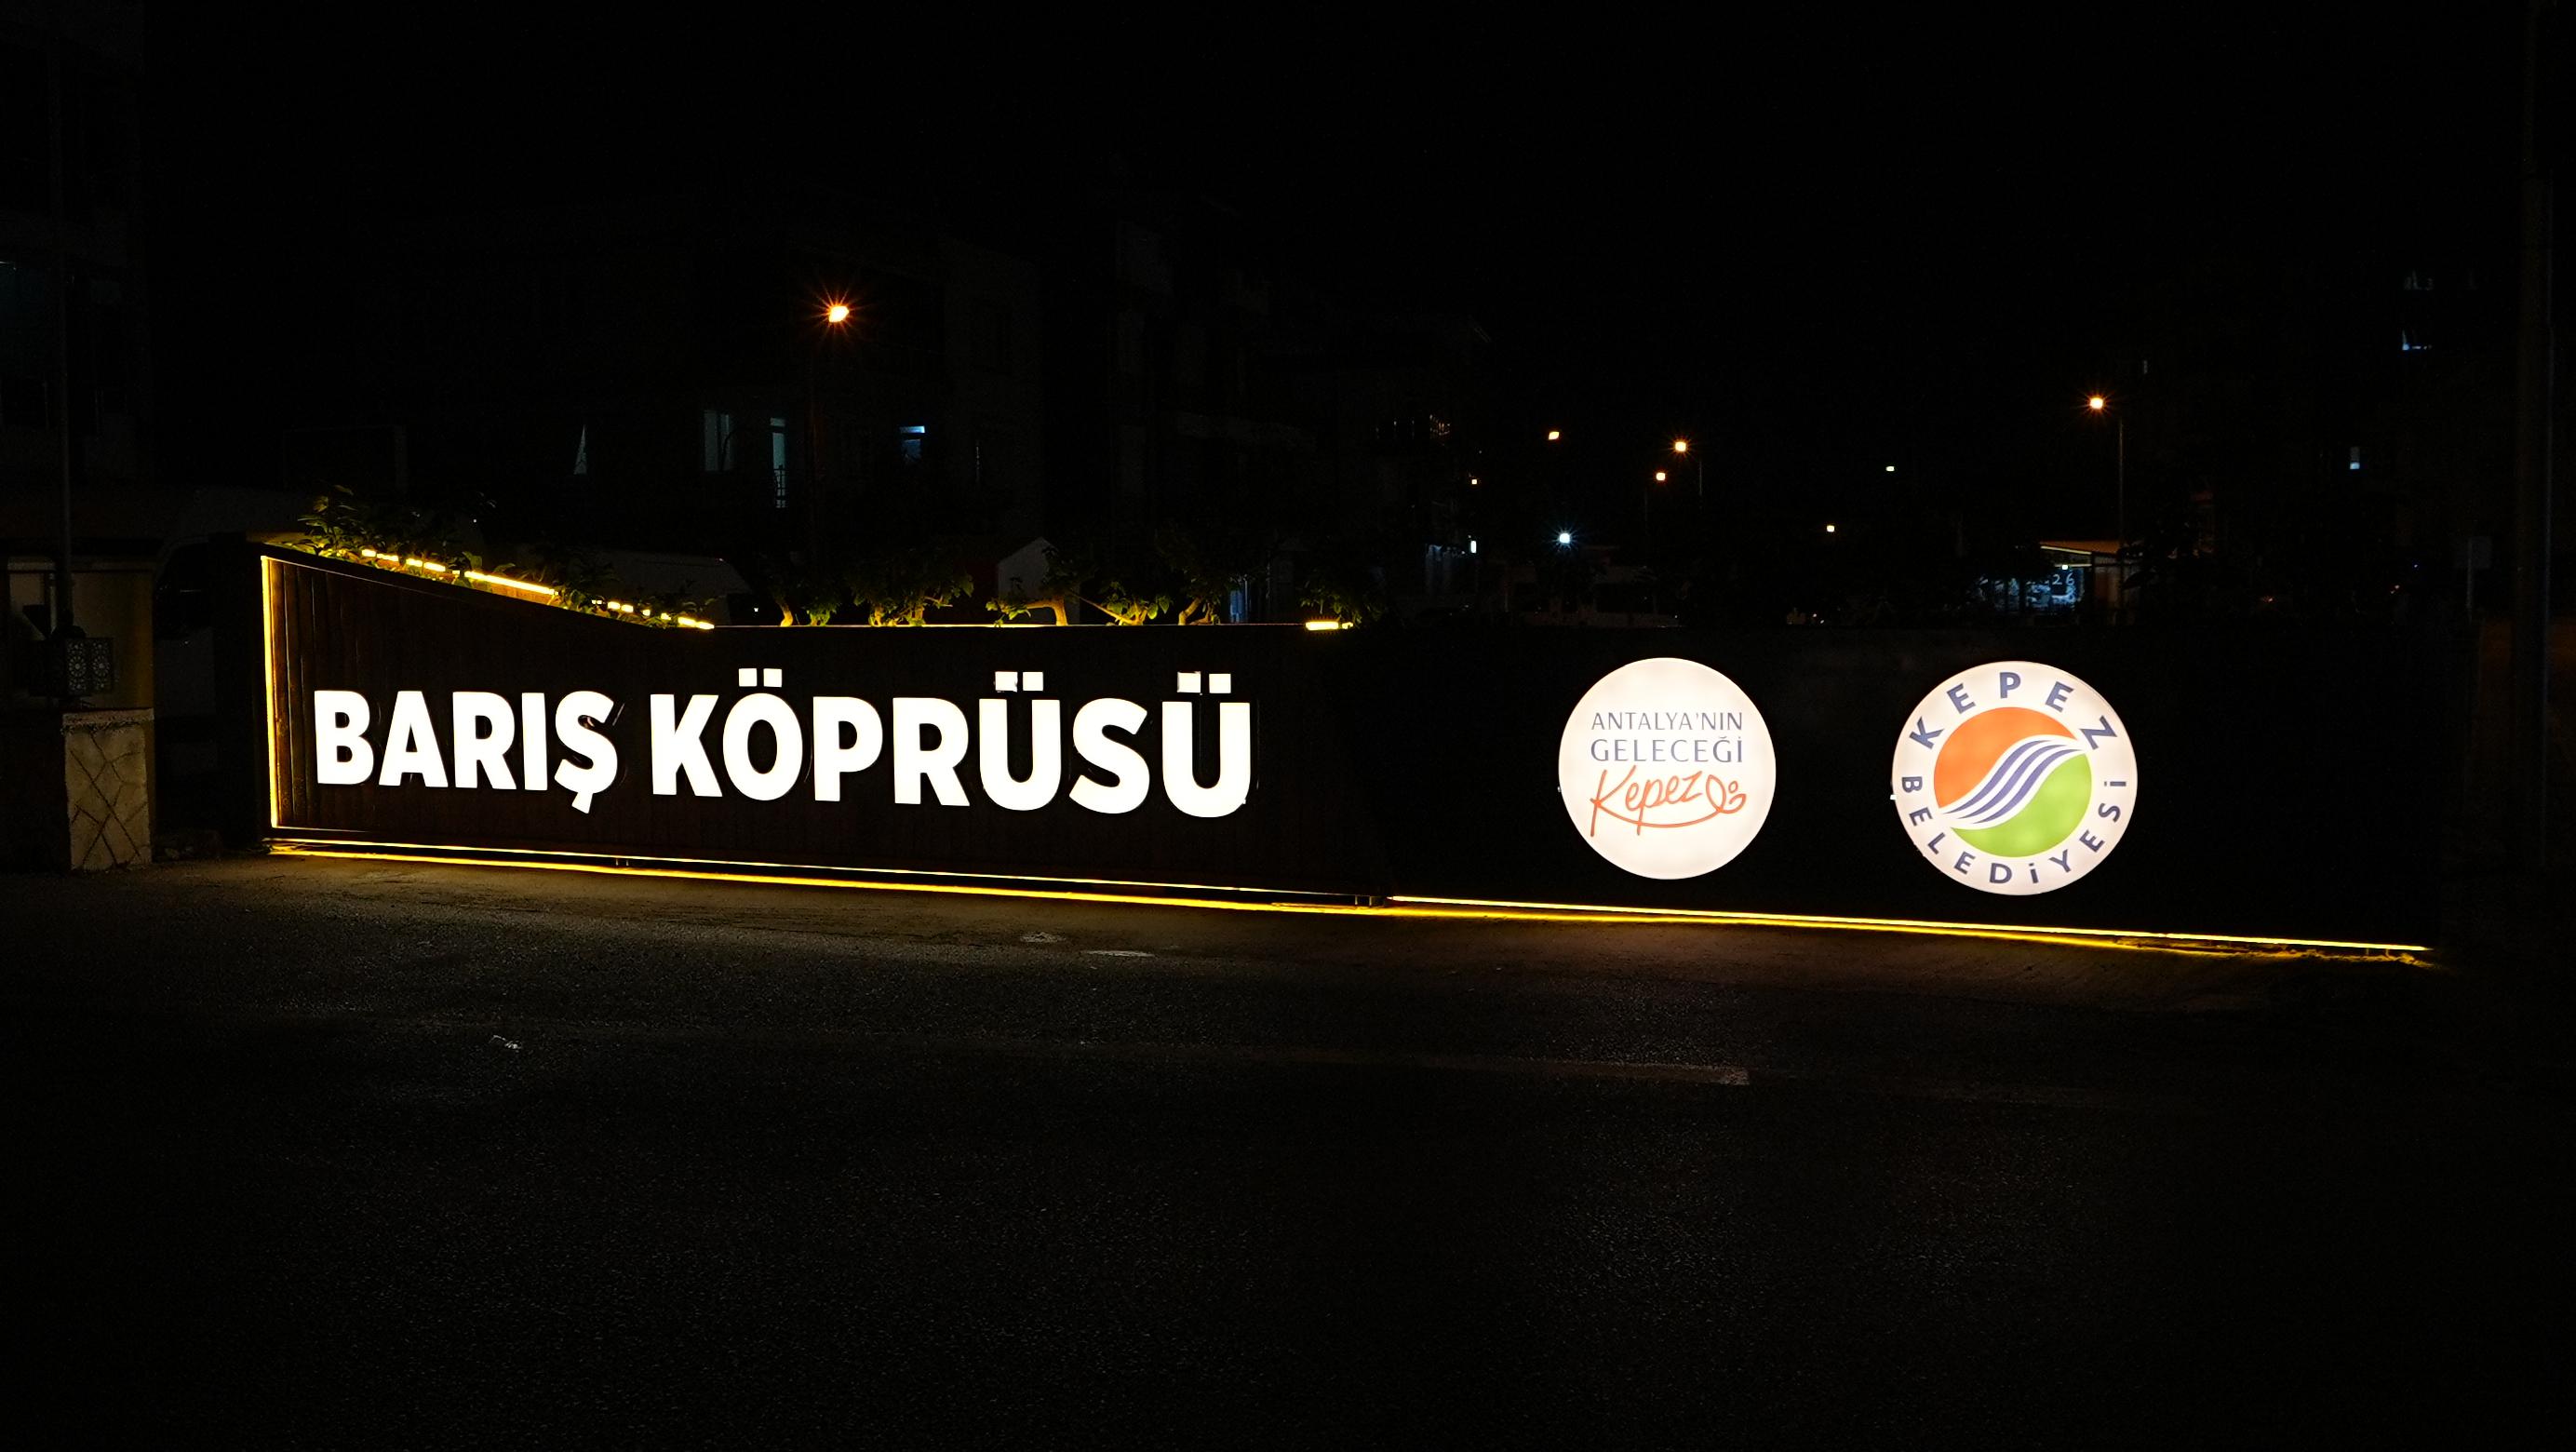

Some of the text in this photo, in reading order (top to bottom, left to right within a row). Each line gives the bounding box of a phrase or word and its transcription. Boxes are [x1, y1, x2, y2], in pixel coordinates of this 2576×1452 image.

[314, 667, 1252, 818] BARIŞ KÖPRÜSÜ
[1591, 711, 1743, 731] ANTALYA'NIN
[1909, 671, 2117, 750] KEPEZ
[1590, 735, 1743, 763] GELECEĞİ
[1590, 764, 1705, 838] Kepez
